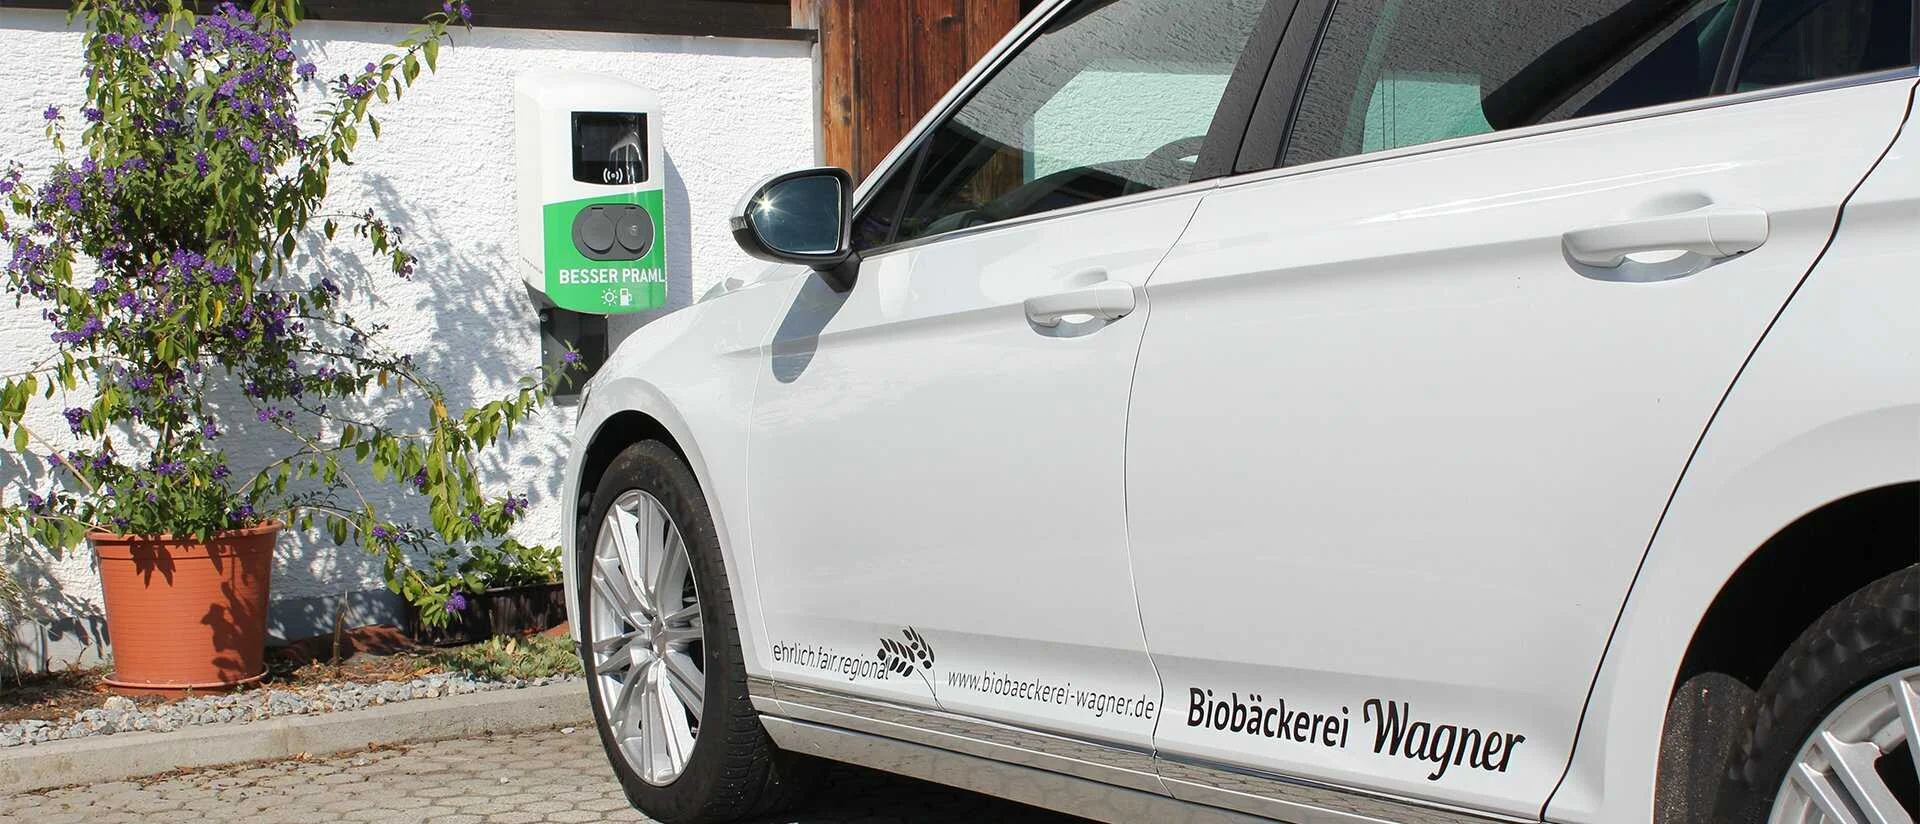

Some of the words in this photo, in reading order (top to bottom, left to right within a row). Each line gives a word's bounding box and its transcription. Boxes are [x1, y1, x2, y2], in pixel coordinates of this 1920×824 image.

[559, 268, 618, 284] BESSER
[622, 267, 666, 283] PRAML
[772, 640, 892, 681] ehrlich.fair.regional
[947, 670, 1155, 720] www.biobaeckerei-wagner.de
[1187, 687, 1350, 749] Biobäckerei
[1363, 697, 1526, 781] Wagner
